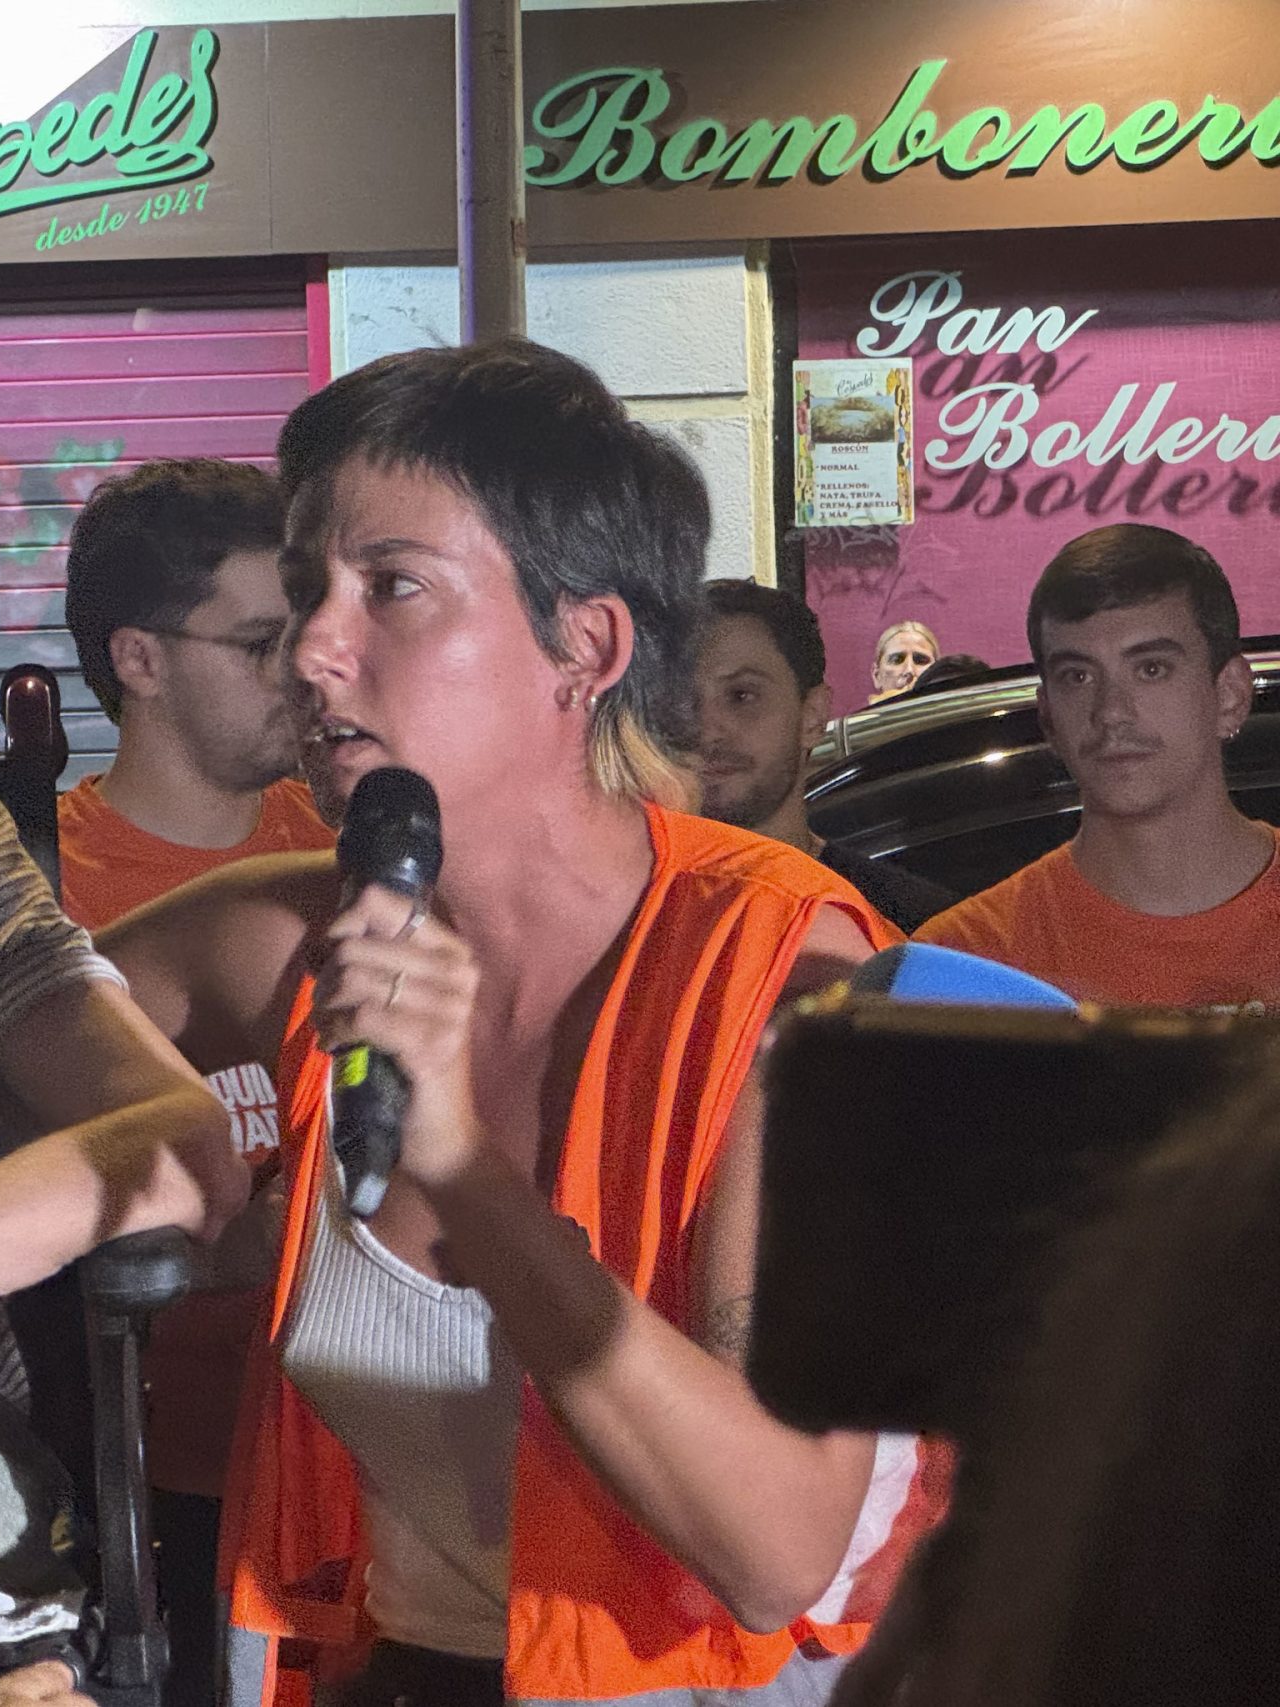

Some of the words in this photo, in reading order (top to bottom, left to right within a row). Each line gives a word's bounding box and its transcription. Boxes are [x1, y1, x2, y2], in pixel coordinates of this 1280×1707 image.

[35, 207, 127, 253] desde
[136, 182, 211, 226] 1947
[856, 270, 1099, 358] Pan
